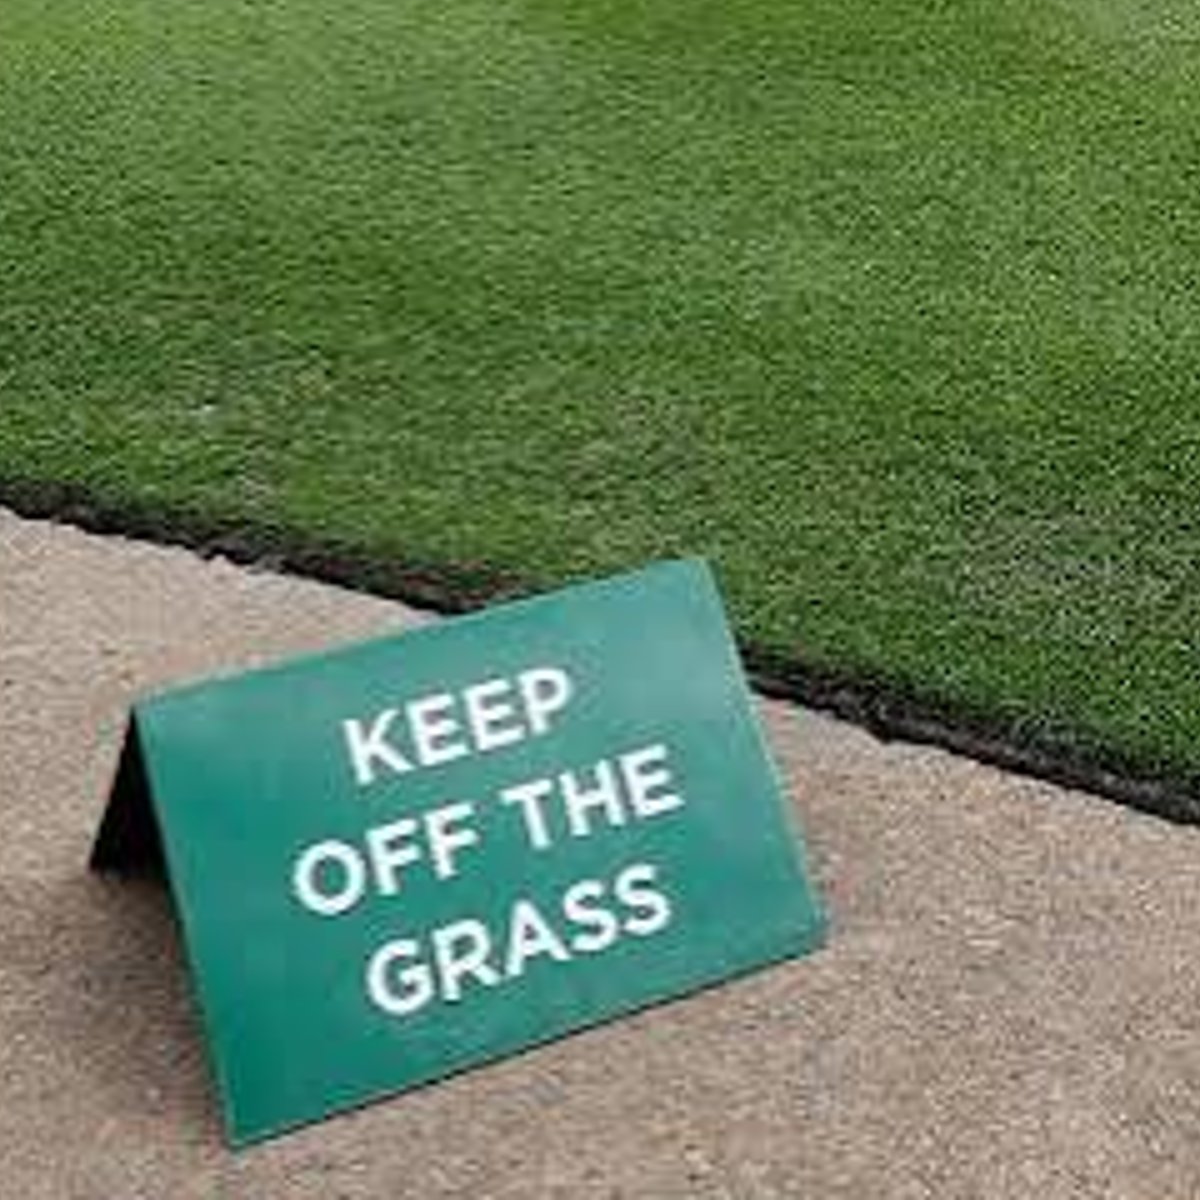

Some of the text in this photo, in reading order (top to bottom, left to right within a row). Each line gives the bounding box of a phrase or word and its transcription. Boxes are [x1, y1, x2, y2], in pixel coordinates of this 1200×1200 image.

[342, 666, 573, 784] KEEP
[293, 744, 685, 915] OFF THE
[366, 864, 672, 1015] GRASS
